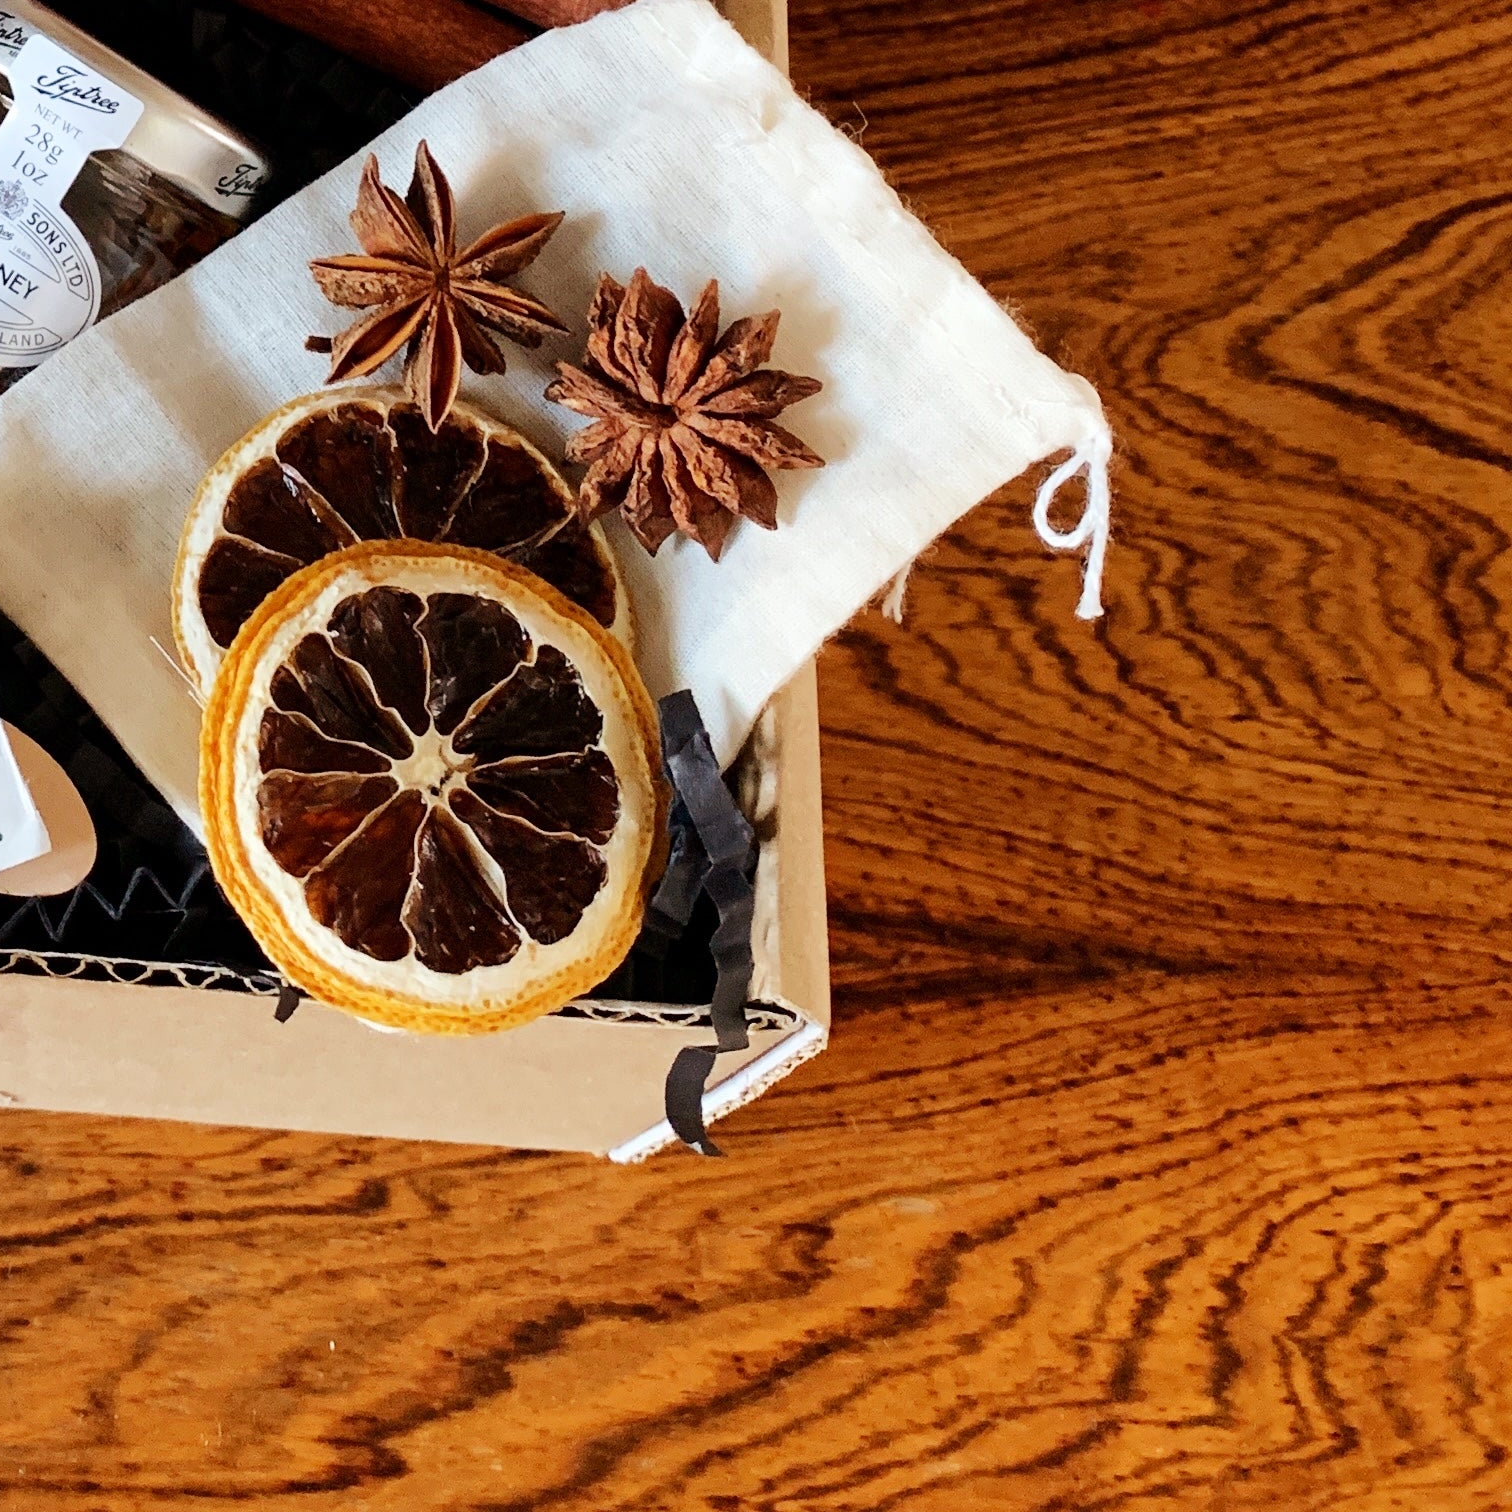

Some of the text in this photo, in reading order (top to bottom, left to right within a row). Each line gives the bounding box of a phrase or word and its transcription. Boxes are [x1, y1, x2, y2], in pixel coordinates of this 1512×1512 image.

[31, 65, 120, 114] Tiptree
[34, 103, 83, 139] NET WT
[25, 124, 64, 165] 28g
[26, 212, 67, 254] SONS
[62, 255, 84, 287] LTD
